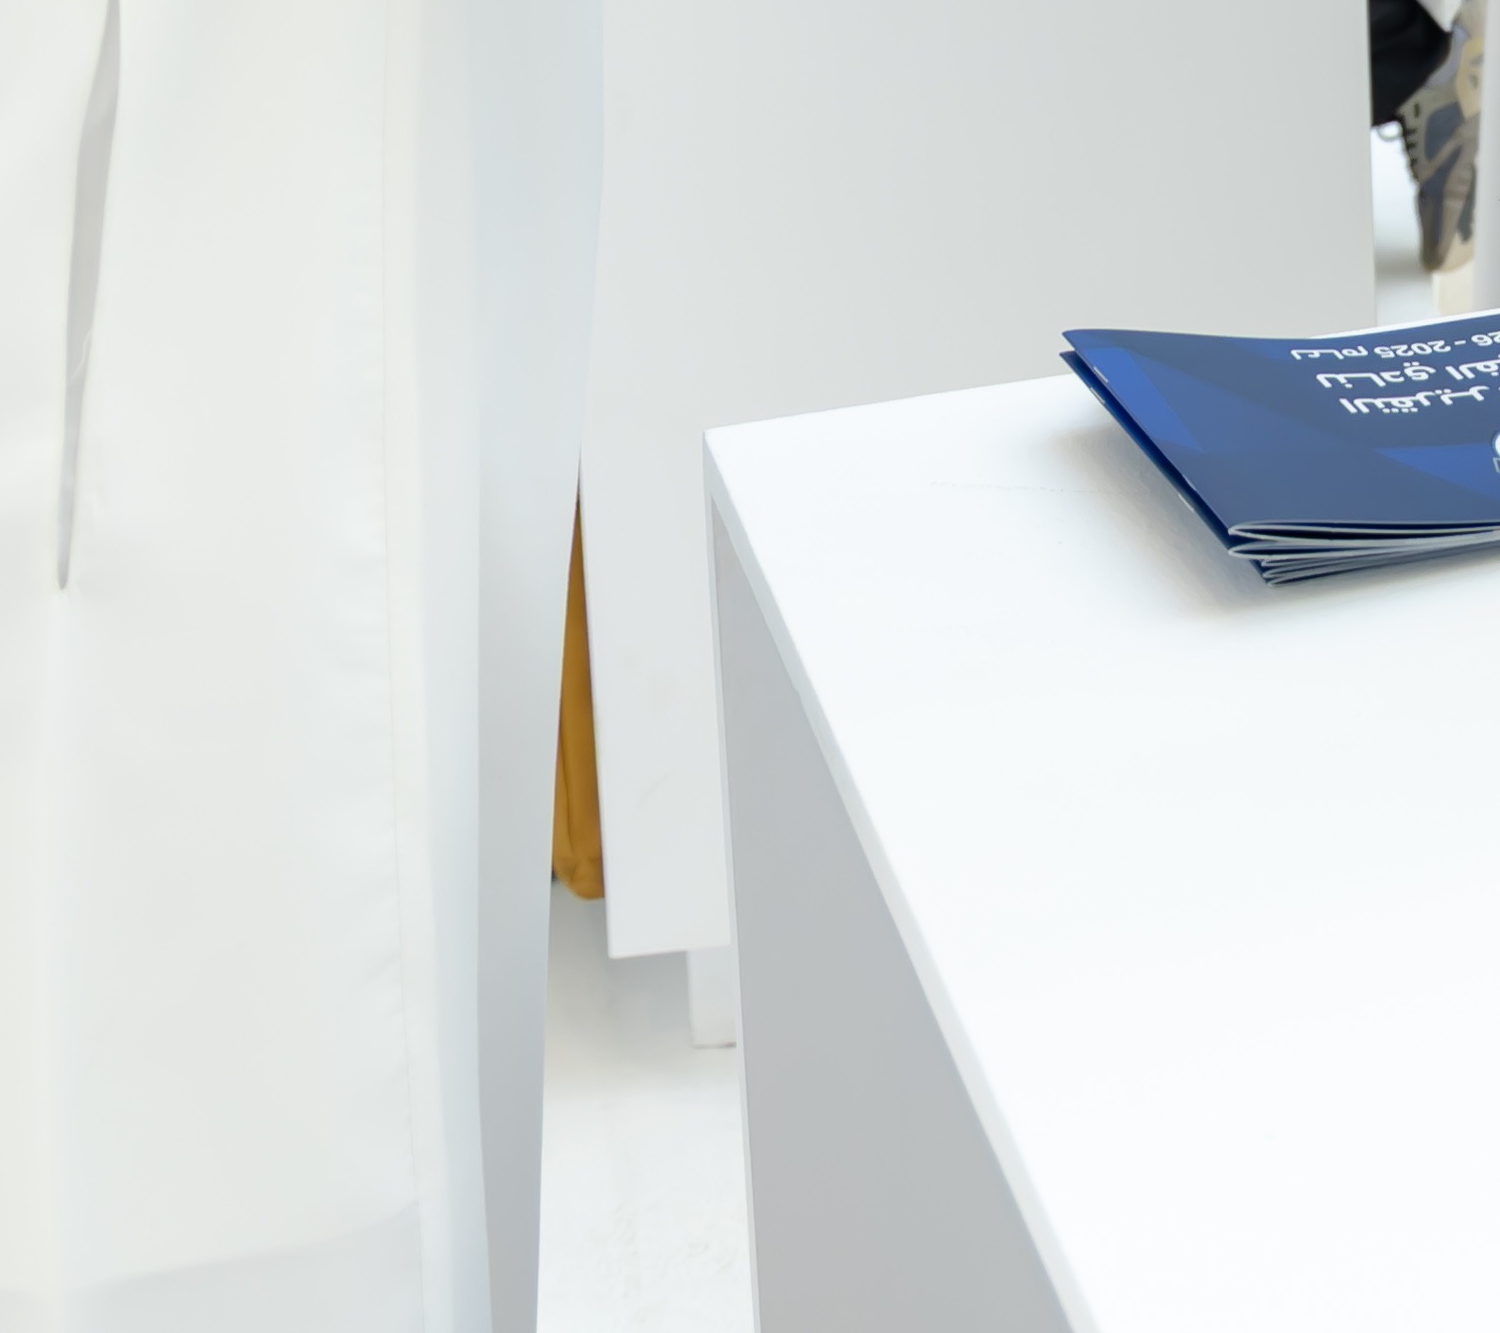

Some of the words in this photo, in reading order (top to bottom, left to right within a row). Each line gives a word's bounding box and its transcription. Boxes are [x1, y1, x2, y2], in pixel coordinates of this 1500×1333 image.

[1290, 345, 1369, 360] لعام
[1373, 339, 1450, 359] 2025
[1316, 361, 1436, 389] لنادي
[1339, 387, 1489, 414] التقرير
